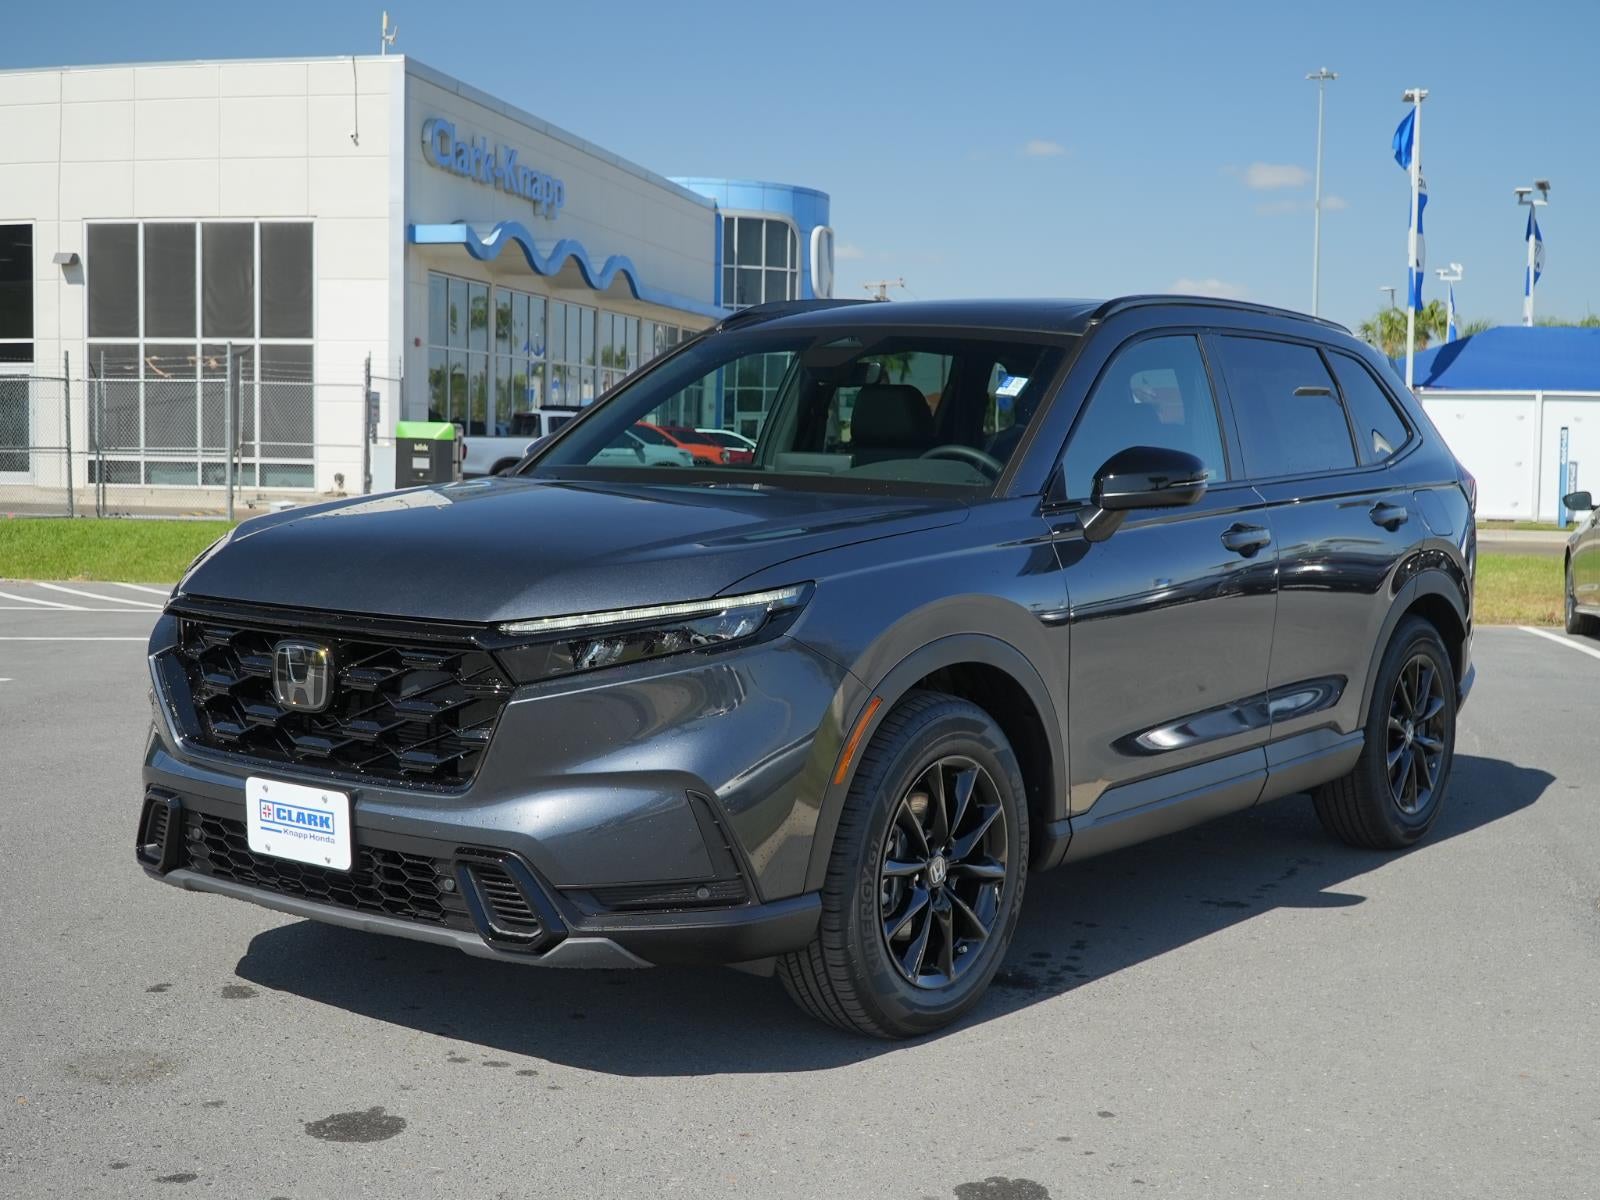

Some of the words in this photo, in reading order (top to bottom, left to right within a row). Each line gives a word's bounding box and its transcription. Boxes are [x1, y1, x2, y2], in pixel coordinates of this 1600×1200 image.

[423, 118, 565, 219] Clark-Knapp
[276, 807, 331, 829] CLARK
[282, 828, 308, 840] Knapp
[309, 833, 335, 844] Honda
